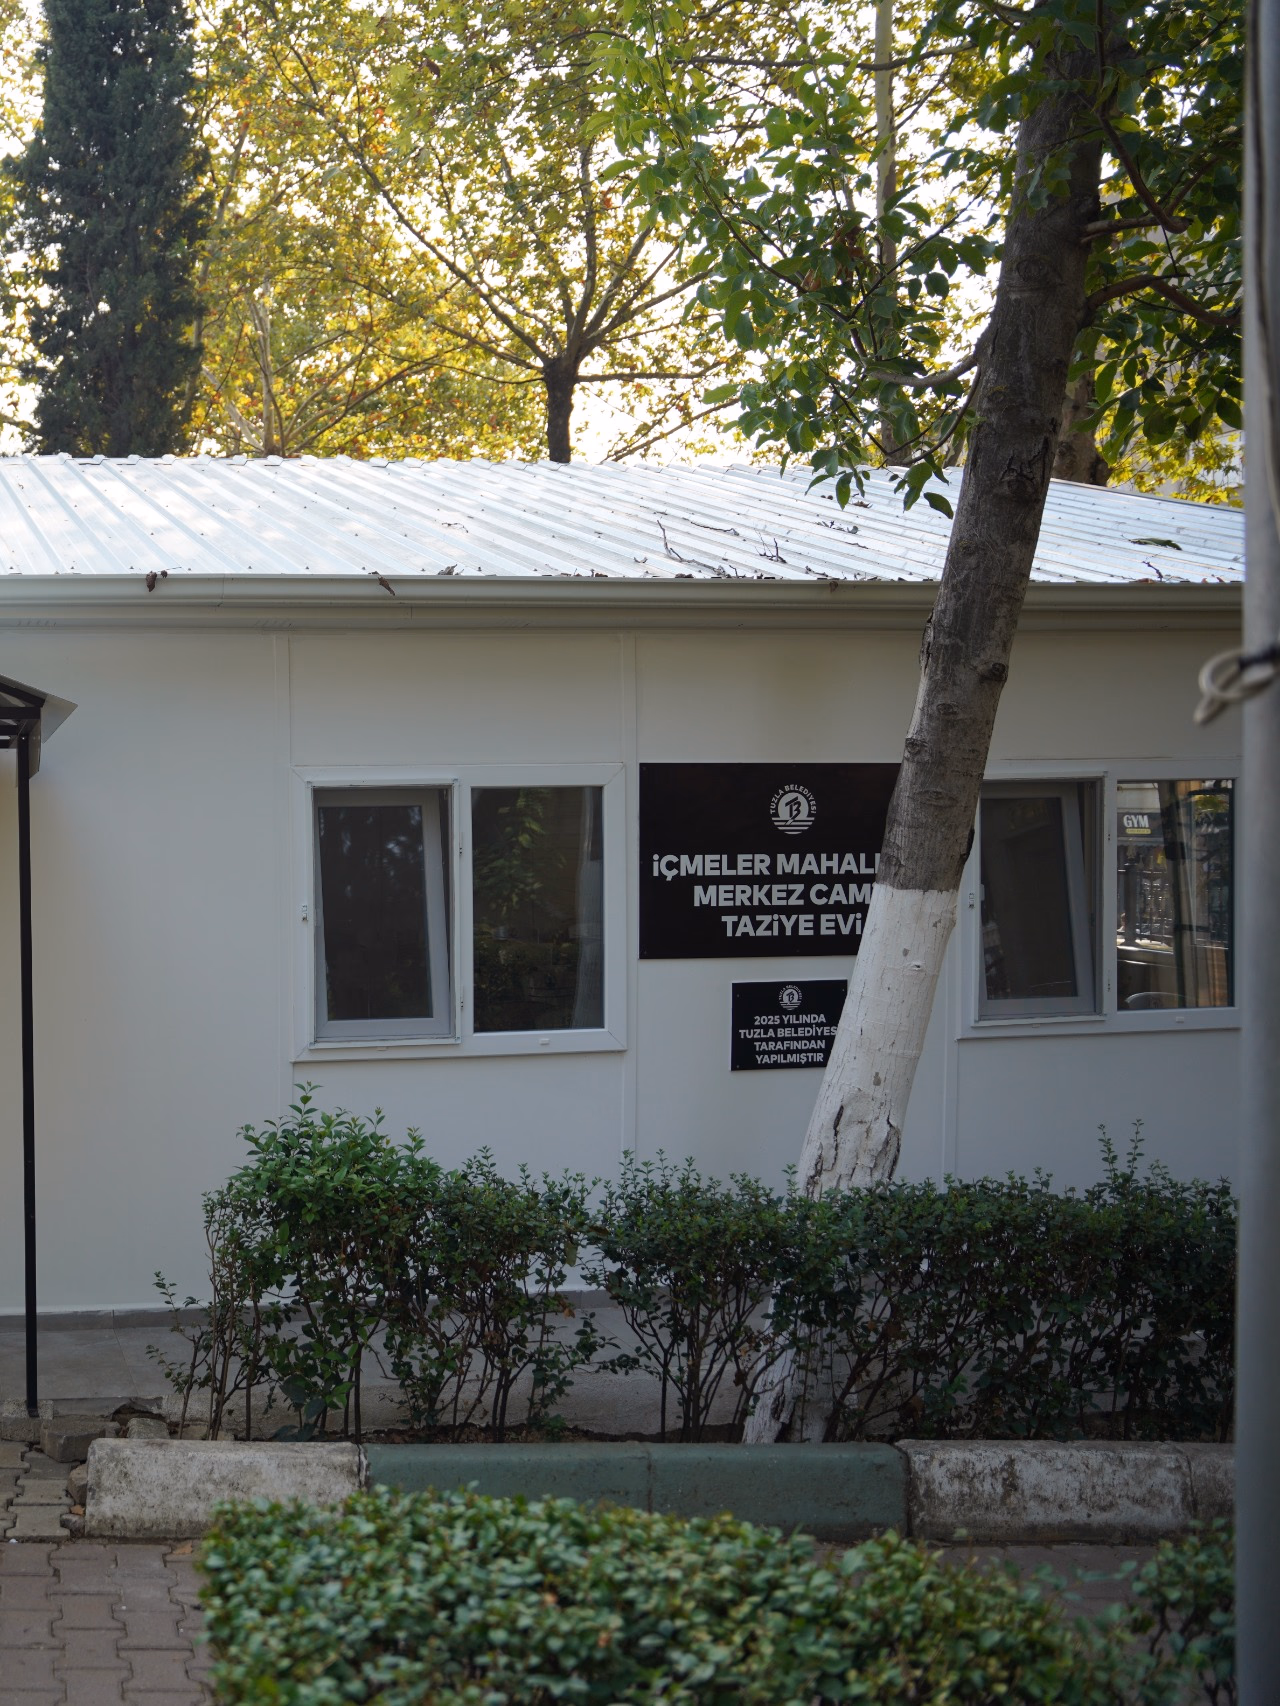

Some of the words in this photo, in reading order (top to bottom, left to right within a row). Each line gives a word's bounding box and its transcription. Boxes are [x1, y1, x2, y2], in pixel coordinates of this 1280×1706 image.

[770, 789, 785, 815] TUZLA
[1123, 814, 1150, 828] GYM
[693, 884, 805, 907] MERKEZ
[809, 883, 872, 906] CAM
[753, 1015, 780, 1025] 2025
[782, 1013, 827, 1025] YILINDA
[738, 1028, 776, 1039] TUZLA
[777, 1024, 837, 1038] BELEDİYES
[753, 1039, 826, 1051] TARAFINDAN
[755, 1052, 824, 1065] YAPILMIŞTIR
